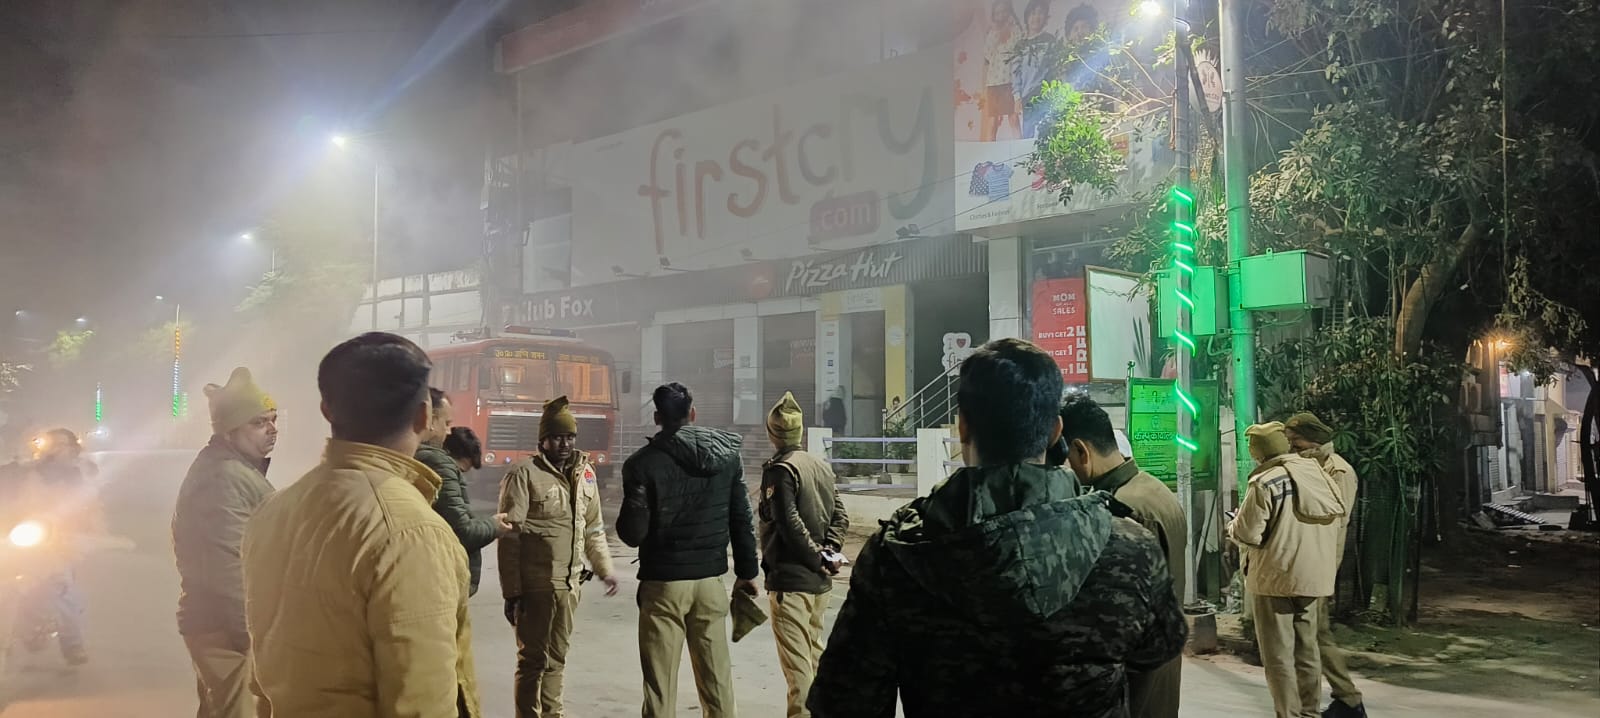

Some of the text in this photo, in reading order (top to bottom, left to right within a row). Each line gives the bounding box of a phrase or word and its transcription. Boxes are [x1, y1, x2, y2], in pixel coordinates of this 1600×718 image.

[638, 85, 939, 254] firstcry
[785, 251, 904, 292] Pizza Hut
[1052, 293, 1076, 302] MOM
[560, 295, 594, 319] Fox
[1052, 306, 1076, 315] SALES
[1066, 326, 1075, 337] 2
[1067, 344, 1073, 356] 1
[1076, 325, 1088, 374] FREE
[1069, 363, 1074, 374] 1
